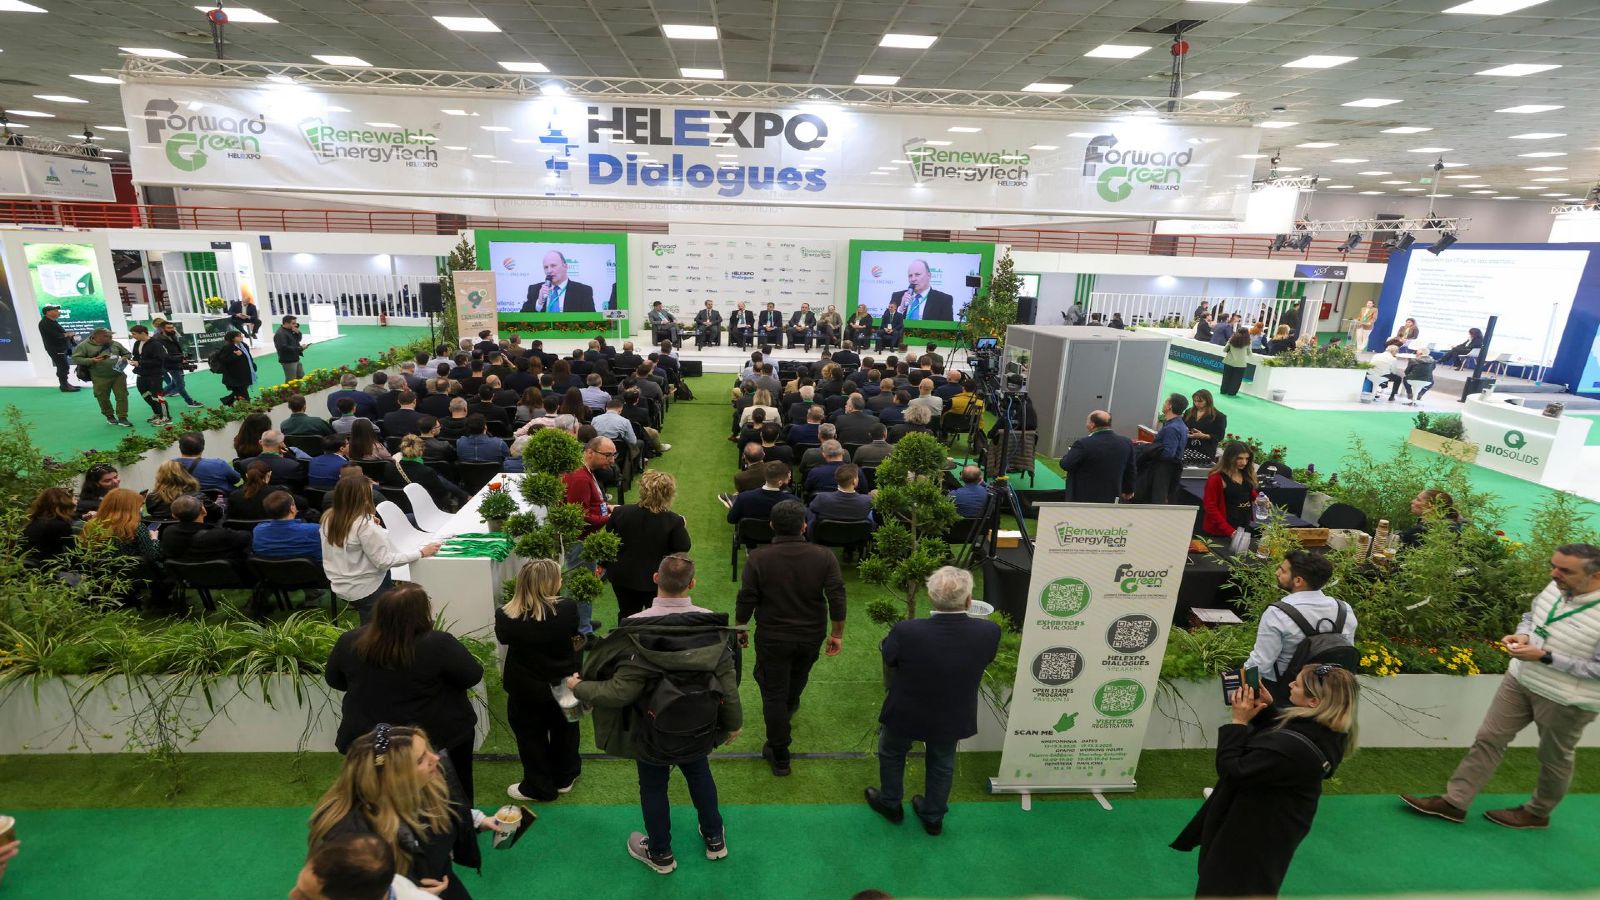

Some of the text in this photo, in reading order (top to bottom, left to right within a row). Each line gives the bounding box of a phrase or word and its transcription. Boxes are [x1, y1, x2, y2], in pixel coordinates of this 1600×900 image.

[144, 98, 267, 144] Forward
[587, 106, 829, 151] HELEXPO
[320, 125, 437, 147] Renewable
[165, 132, 260, 172] Green
[227, 152, 261, 160] HELEXPO
[321, 142, 438, 163] EnergyTech
[921, 146, 1031, 166] Renewable
[1082, 133, 1193, 177] Forward
[588, 153, 828, 198] Dialogues
[921, 162, 1029, 182] EnergyTech
[1096, 166, 1182, 203] Green
[1485, 444, 1540, 466] BIOSOLIDS
[1064, 534, 1127, 546] EnergyTech
[1065, 526, 1129, 537] Renewable
[1114, 563, 1169, 582] Forward
[1120, 577, 1163, 594] Green
